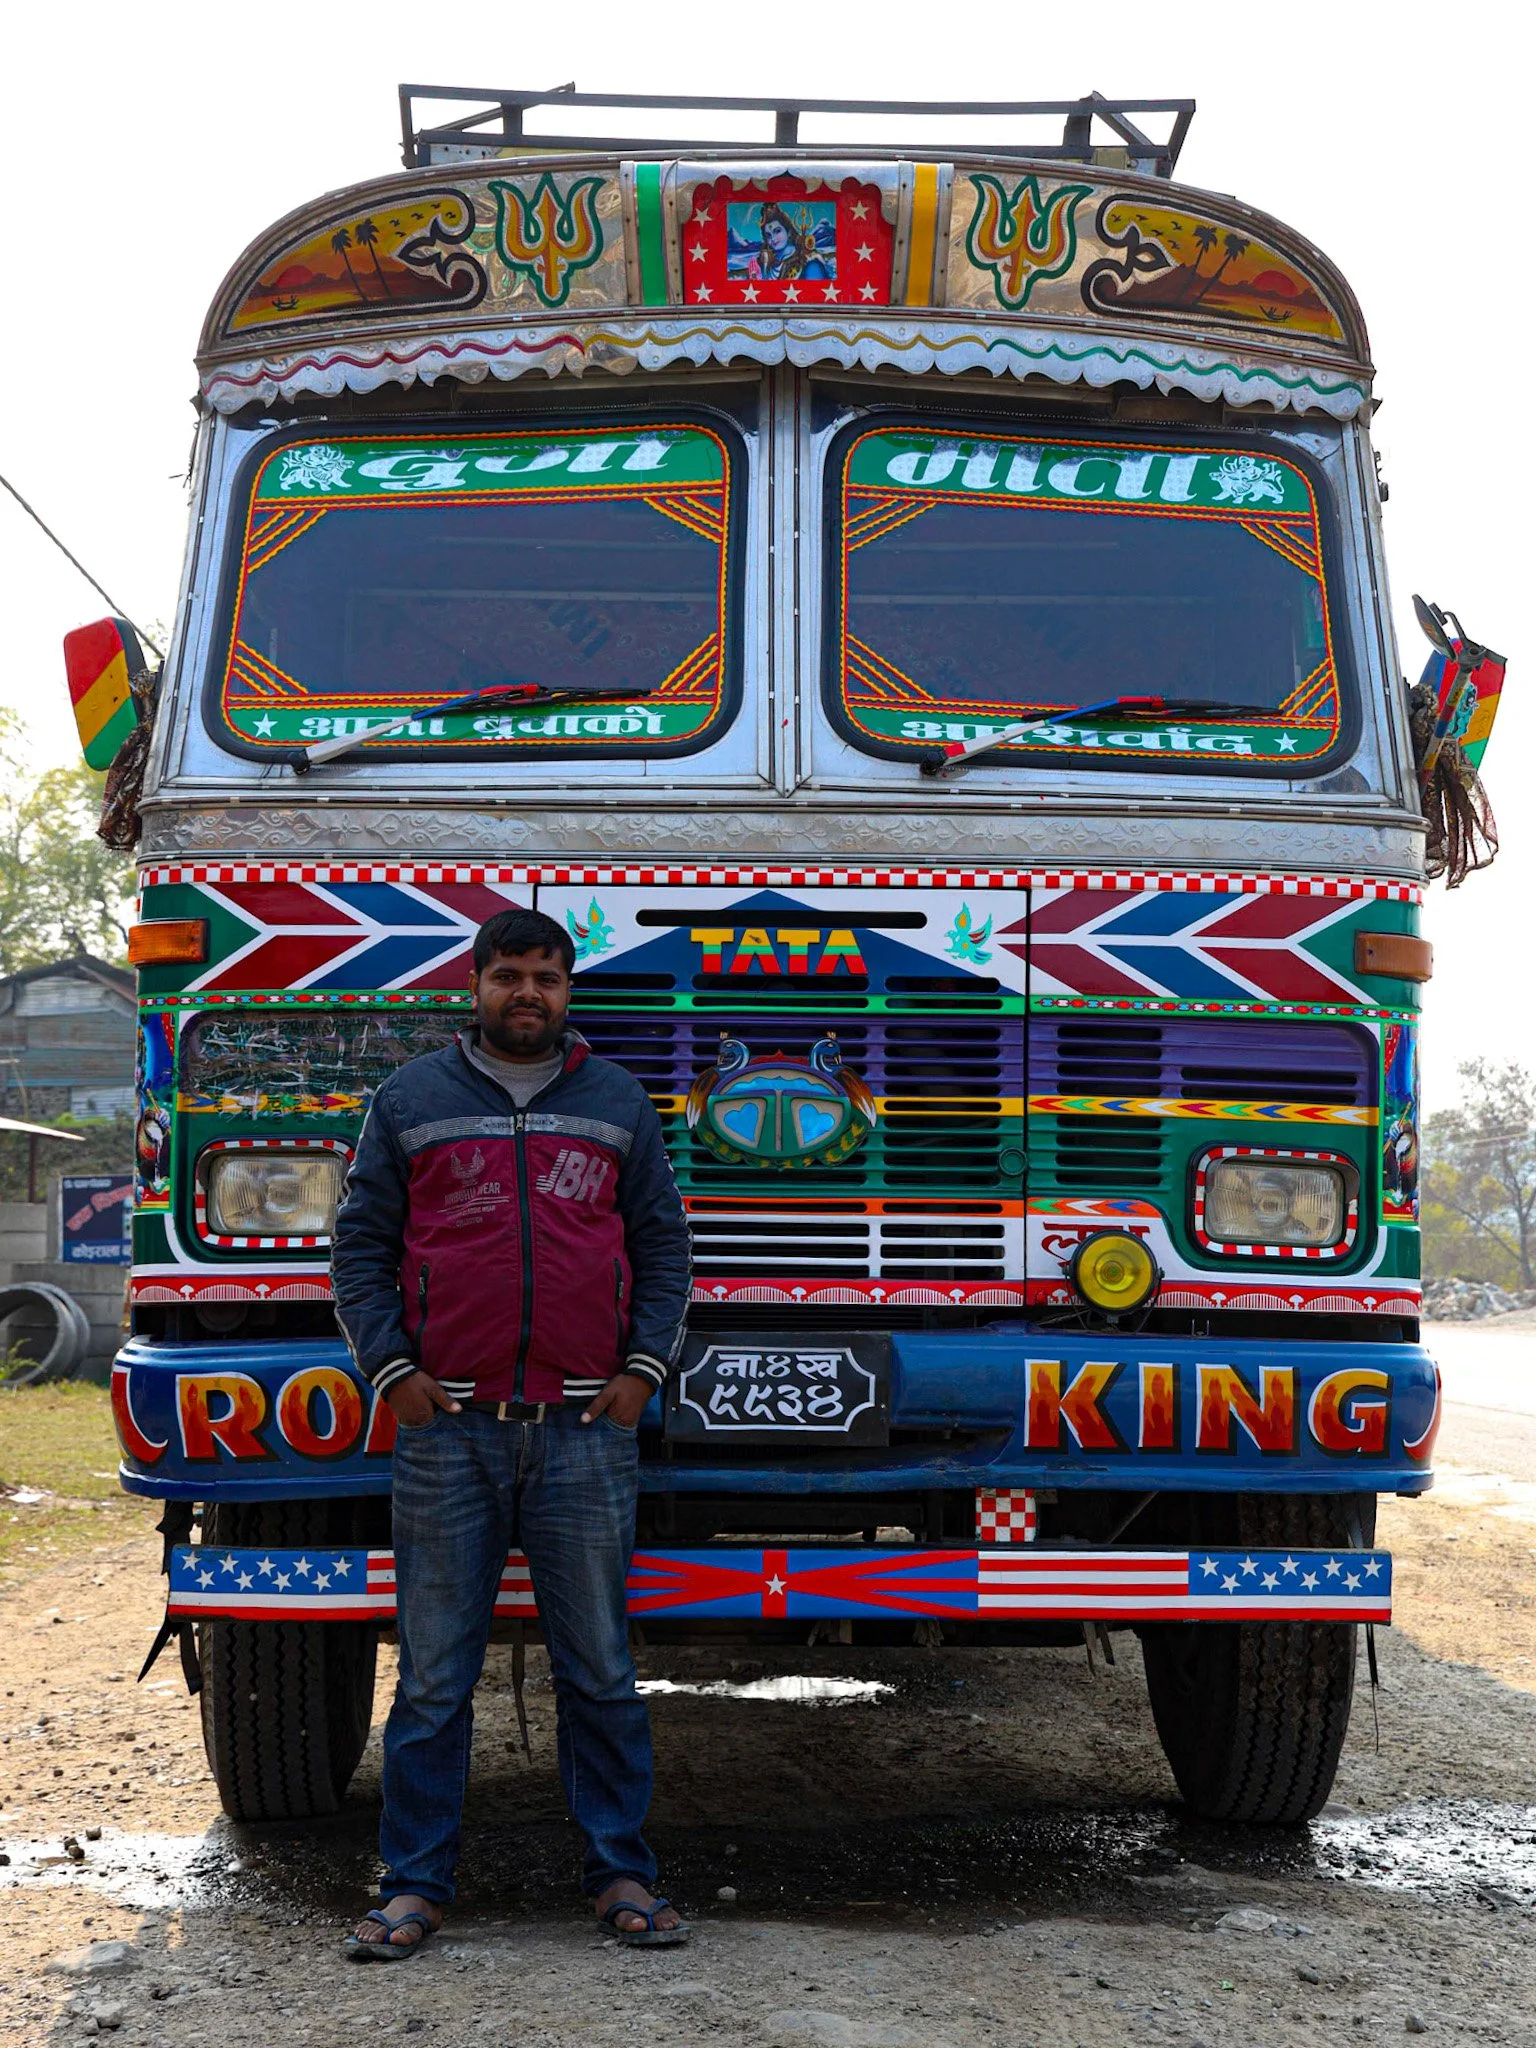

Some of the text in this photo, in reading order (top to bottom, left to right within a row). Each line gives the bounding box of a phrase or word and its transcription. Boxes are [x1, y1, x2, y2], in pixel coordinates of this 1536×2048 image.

[886, 436, 1212, 502] माता
[690, 928, 869, 975] TATA
[536, 1149, 610, 1205] JBH
[176, 1358, 1393, 1461] RO KING
[709, 1384, 844, 1424] ५५३४
